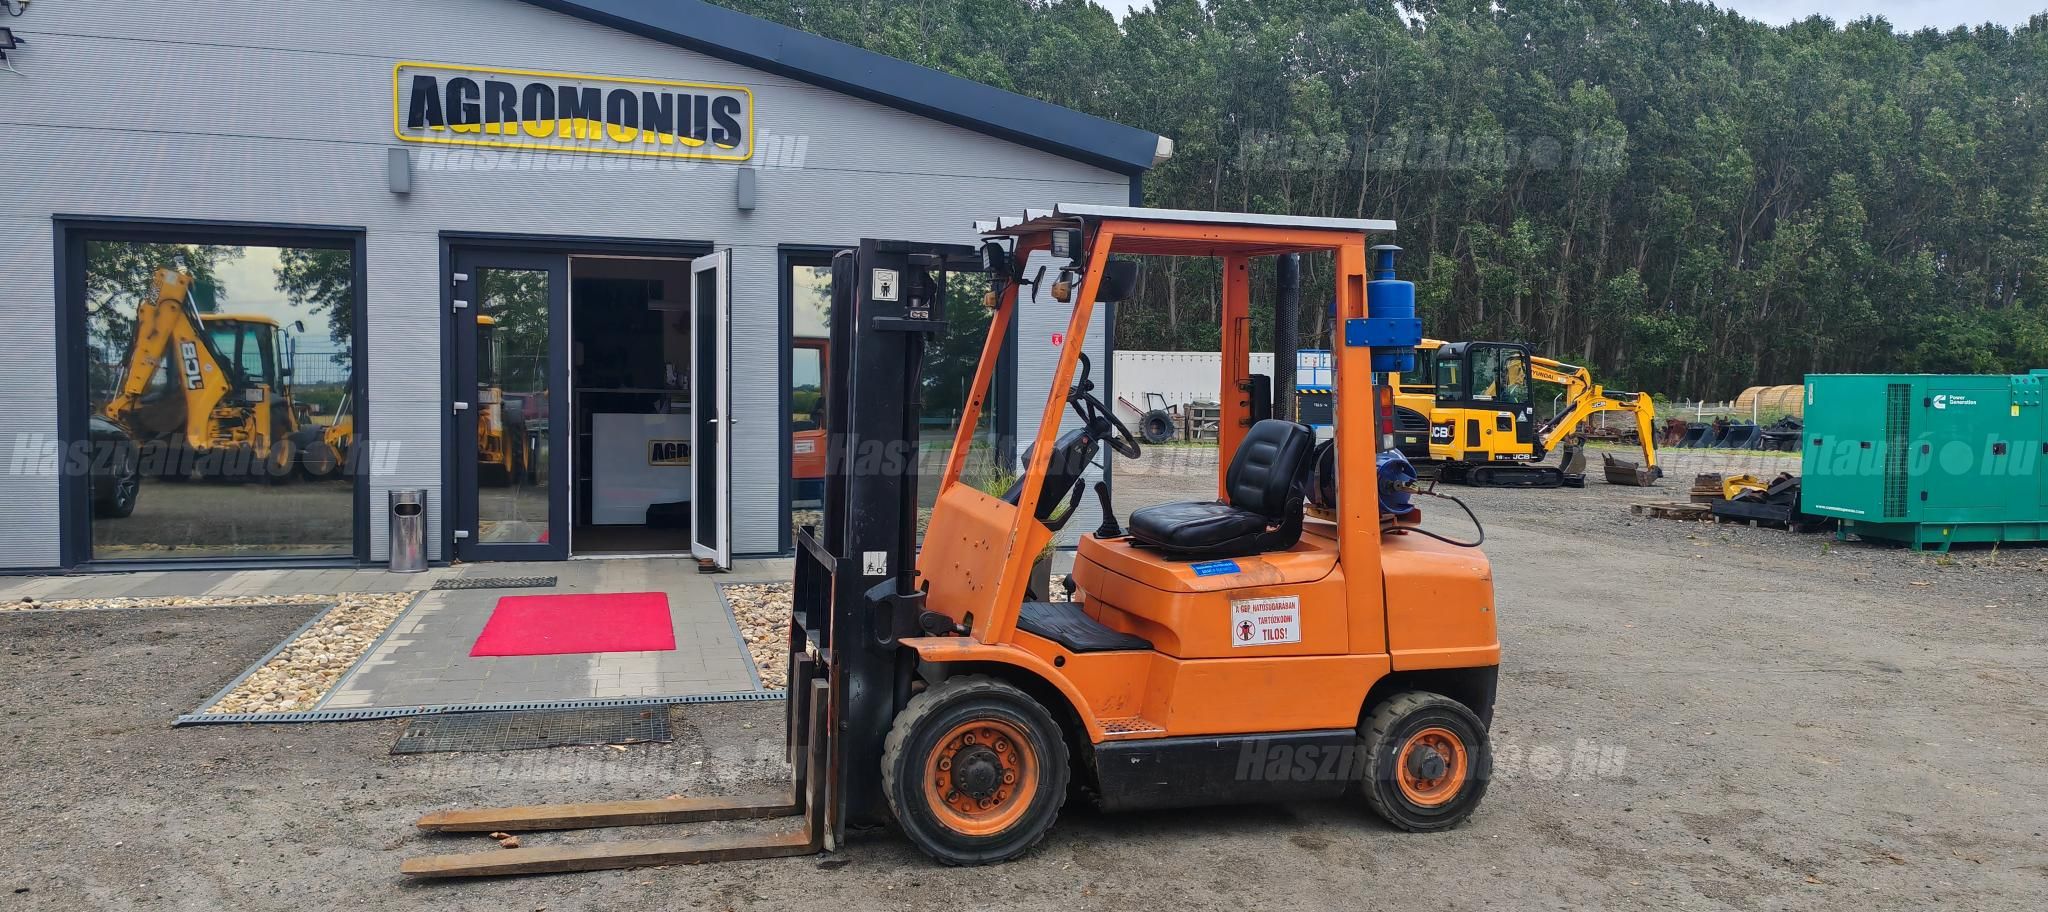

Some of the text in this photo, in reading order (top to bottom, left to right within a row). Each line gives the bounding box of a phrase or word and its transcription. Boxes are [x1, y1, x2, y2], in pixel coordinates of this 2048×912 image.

[407, 75, 742, 149] AGROMONUS
[1532, 370, 1554, 380] YUNDAI
[652, 442, 691, 463] AGR
[1262, 627, 1288, 640] TILOS!
